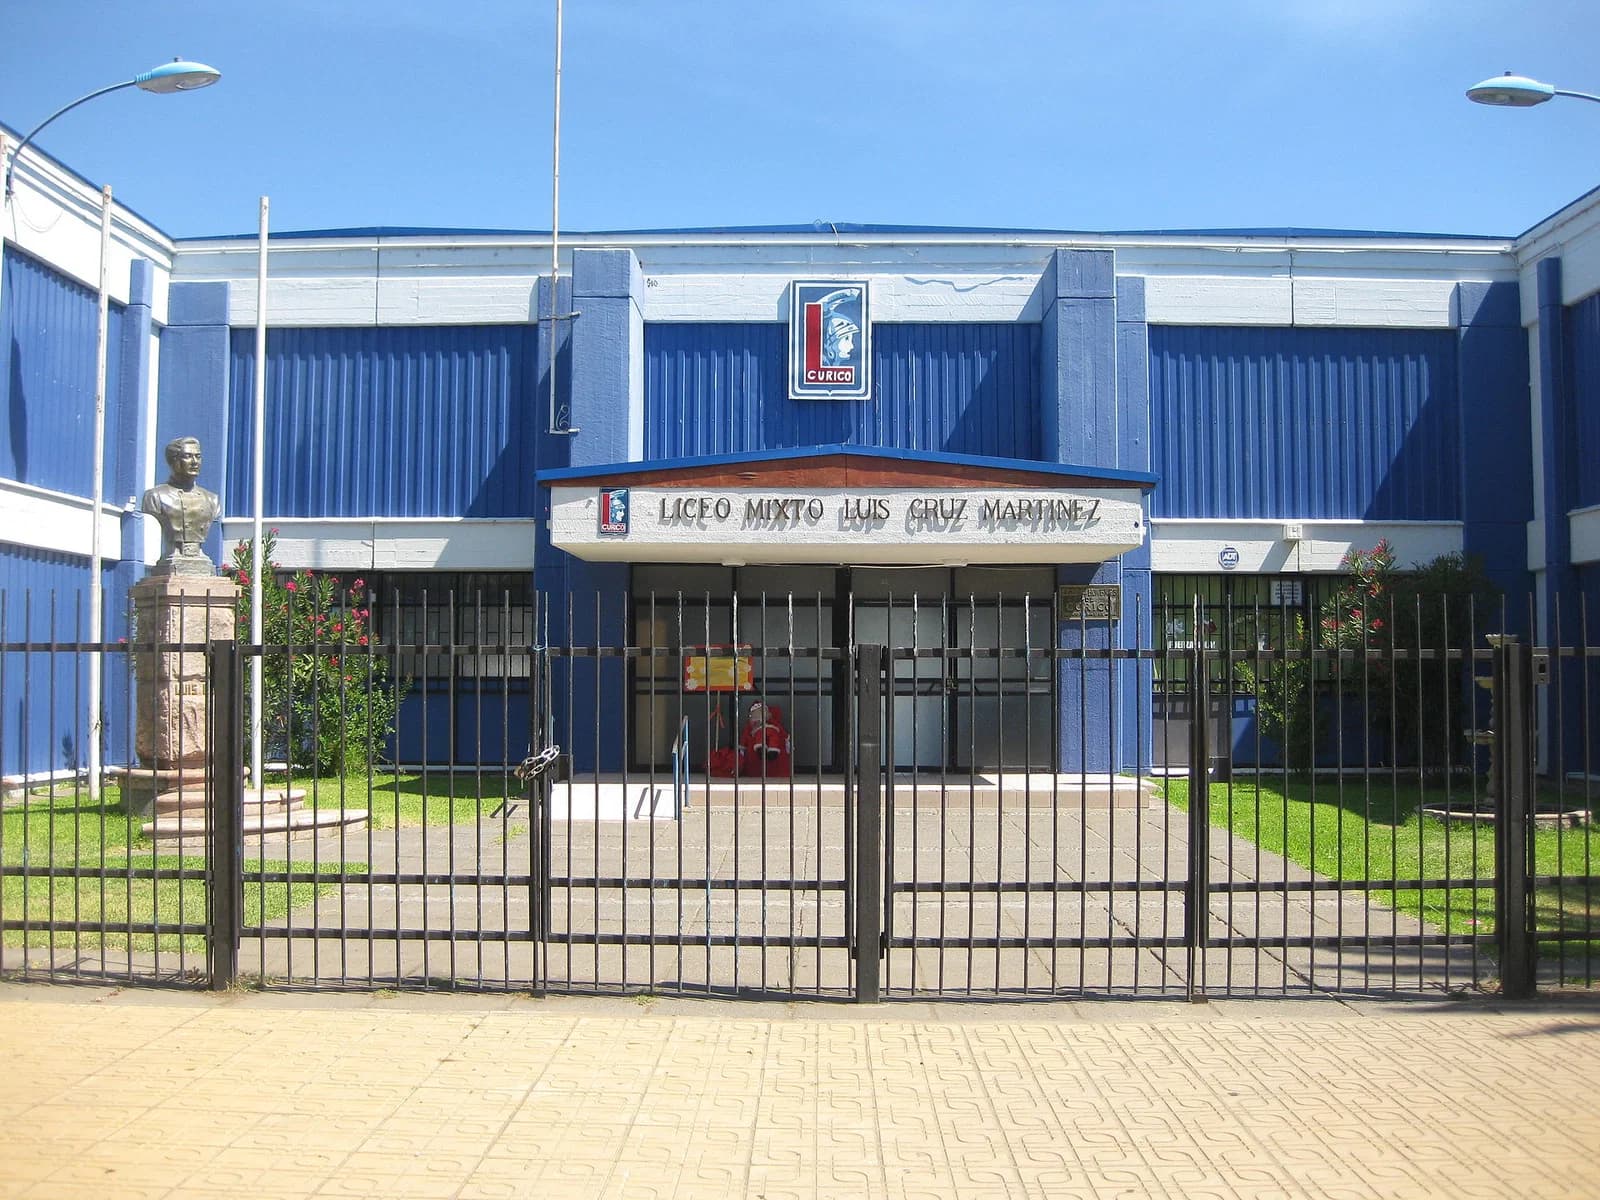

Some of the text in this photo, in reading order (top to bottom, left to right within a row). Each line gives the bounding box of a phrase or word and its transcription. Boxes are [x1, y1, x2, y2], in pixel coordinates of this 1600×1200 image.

[807, 370, 851, 381] CURICO
[662, 497, 1101, 521] LICEO MIXTO LUIS CRUZ MARTINEZ
